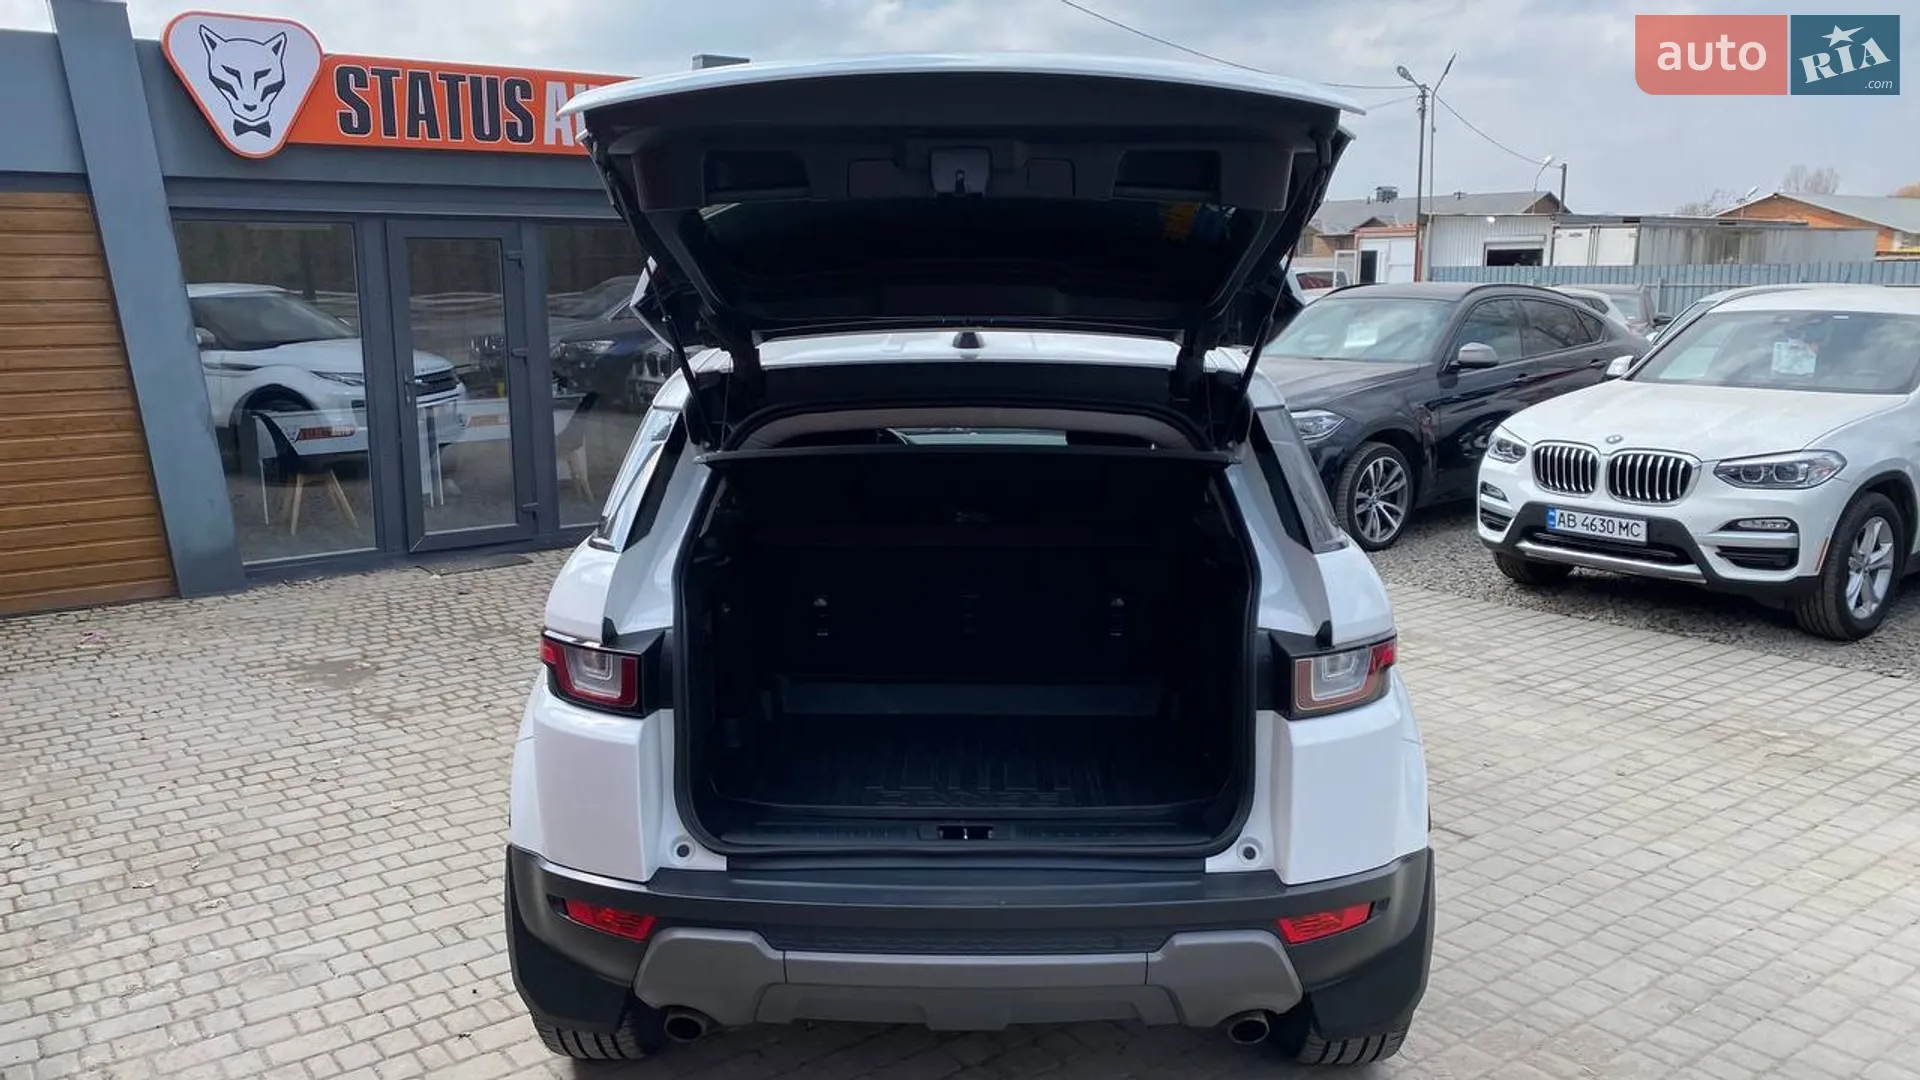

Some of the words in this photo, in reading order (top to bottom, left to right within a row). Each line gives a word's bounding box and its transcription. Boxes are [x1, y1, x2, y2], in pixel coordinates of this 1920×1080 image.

[334, 64, 536, 144] STATUS
[543, 80, 602, 147] A
[1557, 512, 1577, 529] AB
[1581, 516, 1615, 534] 4630
[1618, 520, 1641, 538] MC
